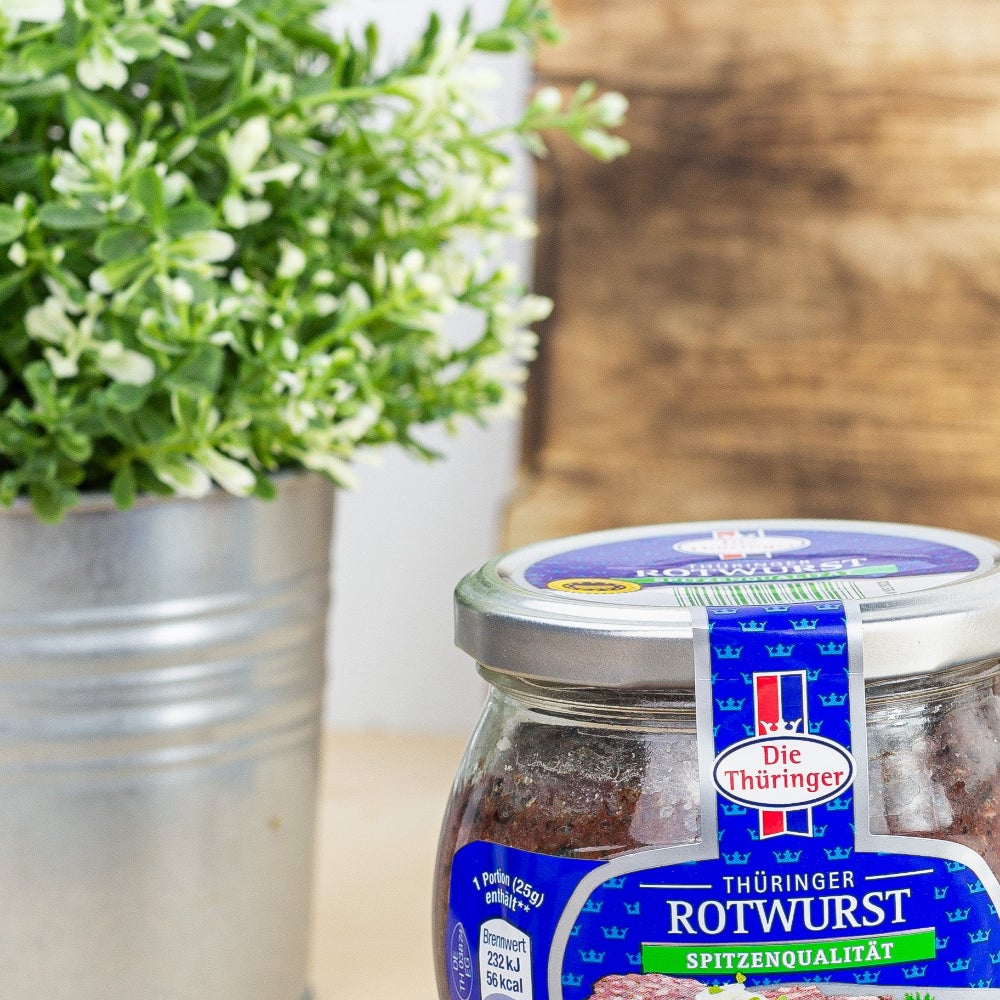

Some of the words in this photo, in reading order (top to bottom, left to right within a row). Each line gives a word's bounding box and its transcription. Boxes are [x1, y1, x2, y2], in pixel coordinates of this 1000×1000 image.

[636, 557, 868, 577] ROTWURST
[763, 744, 801, 765] Die
[724, 768, 844, 793] Thüringer
[472, 876, 481, 891] 1
[482, 868, 510, 887] Portion
[512, 876, 545, 908] (25g)
[722, 869, 855, 894] THÜRINGER
[666, 888, 911, 935] ROTWURST
[483, 928, 527, 953] Brennwert
[487, 950, 504, 970] 232
[506, 955, 520, 973] kJ
[686, 941, 895, 970] SPITZENQUALITÄT
[486, 971, 498, 988] 56
[500, 974, 523, 993] kcal
